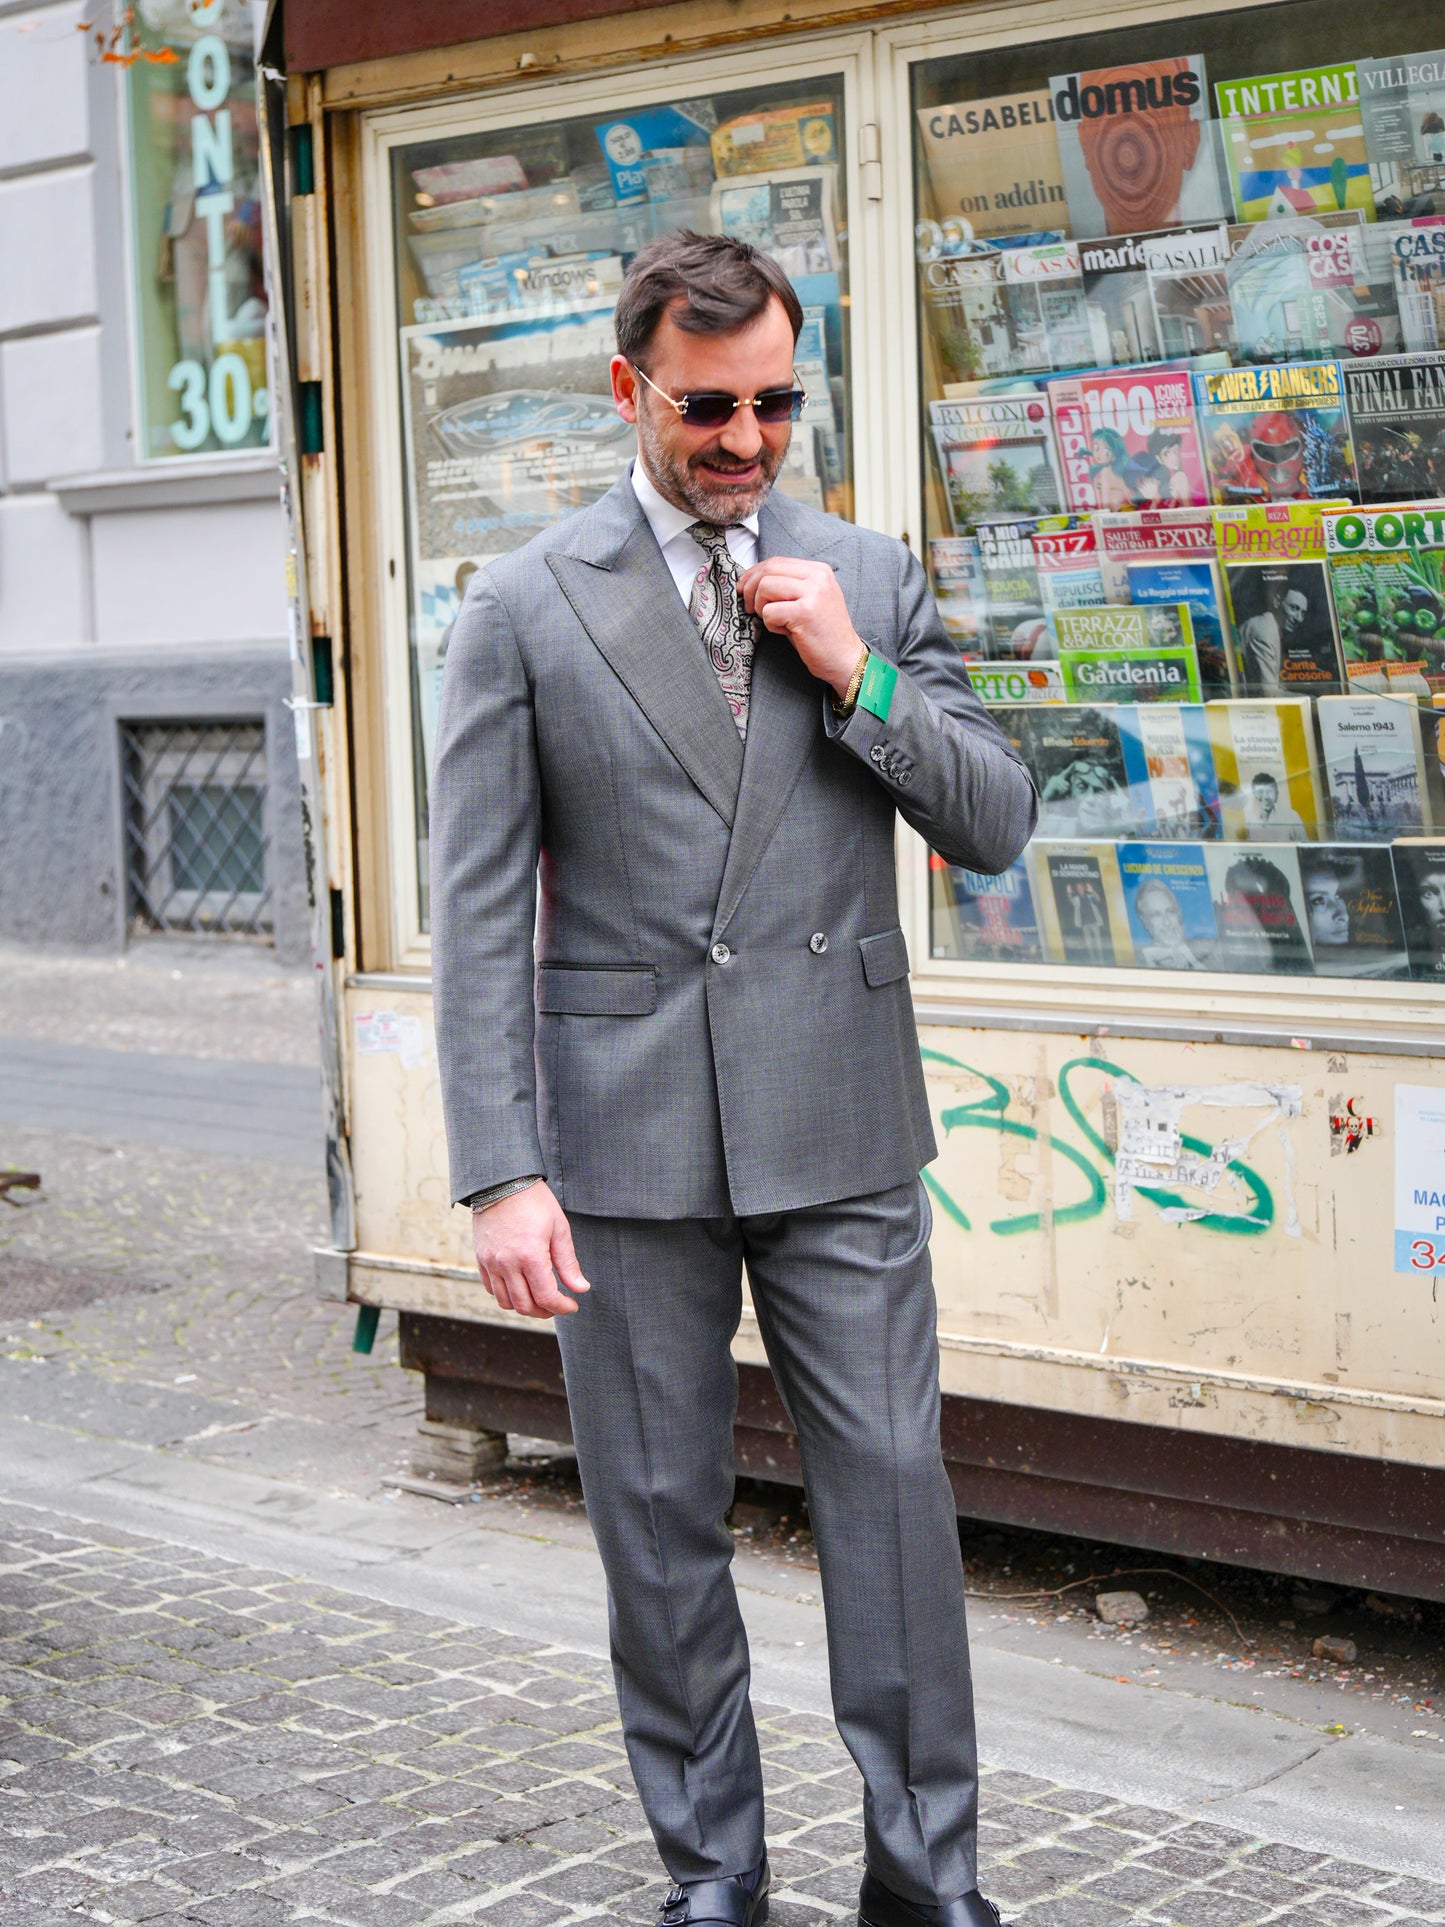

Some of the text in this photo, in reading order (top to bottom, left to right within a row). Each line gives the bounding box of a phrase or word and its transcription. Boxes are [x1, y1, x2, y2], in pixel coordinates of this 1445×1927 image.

[1055, 71, 1201, 122] domus
[1225, 71, 1359, 117] INTERNI
[959, 193, 990, 214] on
[521, 266, 597, 290] Windows
[1309, 254, 1371, 279] CASA
[1350, 325, 1371, 353] 370
[1205, 364, 1340, 403] POWER RANGERS
[1348, 370, 1409, 414] FINAL
[940, 402, 1027, 426] BALCONI
[1083, 384, 1156, 437] 100
[1105, 530, 1142, 542] SALUTE
[1153, 526, 1217, 549] EXTRA
[1034, 535, 1094, 568] RIZ
[1188, 587, 1210, 596] mare
[1057, 614, 1144, 633] TERRAZZI
[1076, 657, 1182, 685] Gardenia
[1279, 669, 1333, 682] Carosone
[1283, 657, 1317, 671] Canta
[1337, 721, 1395, 732] Salerno 1943
[1073, 735, 1109, 747] Eduardo
[1234, 735, 1281, 746] La stampa
[1240, 744, 1279, 753] addosso
[965, 872, 1019, 895] NAPOLI
